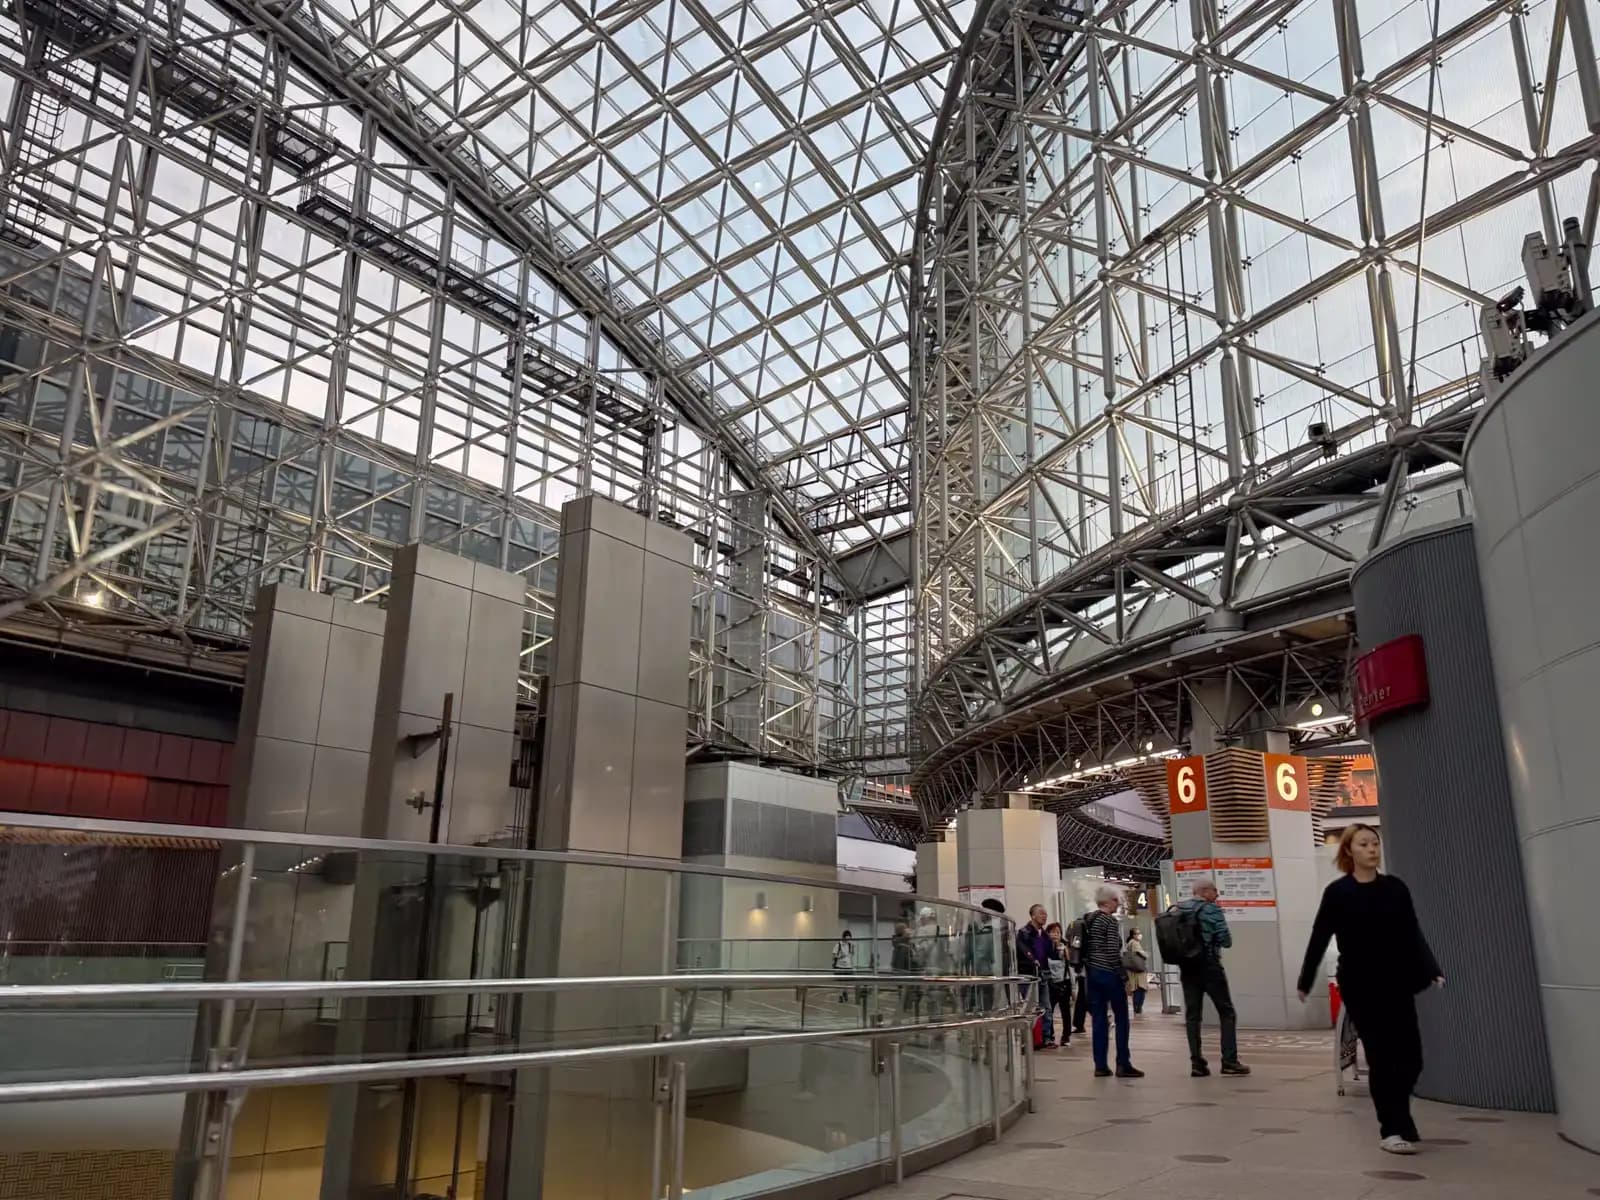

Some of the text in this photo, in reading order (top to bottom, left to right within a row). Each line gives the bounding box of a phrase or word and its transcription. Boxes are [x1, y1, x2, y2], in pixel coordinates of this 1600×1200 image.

[1178, 766, 1196, 803] 6
[1277, 763, 1298, 802] 6
[1138, 892, 1147, 907] 4
